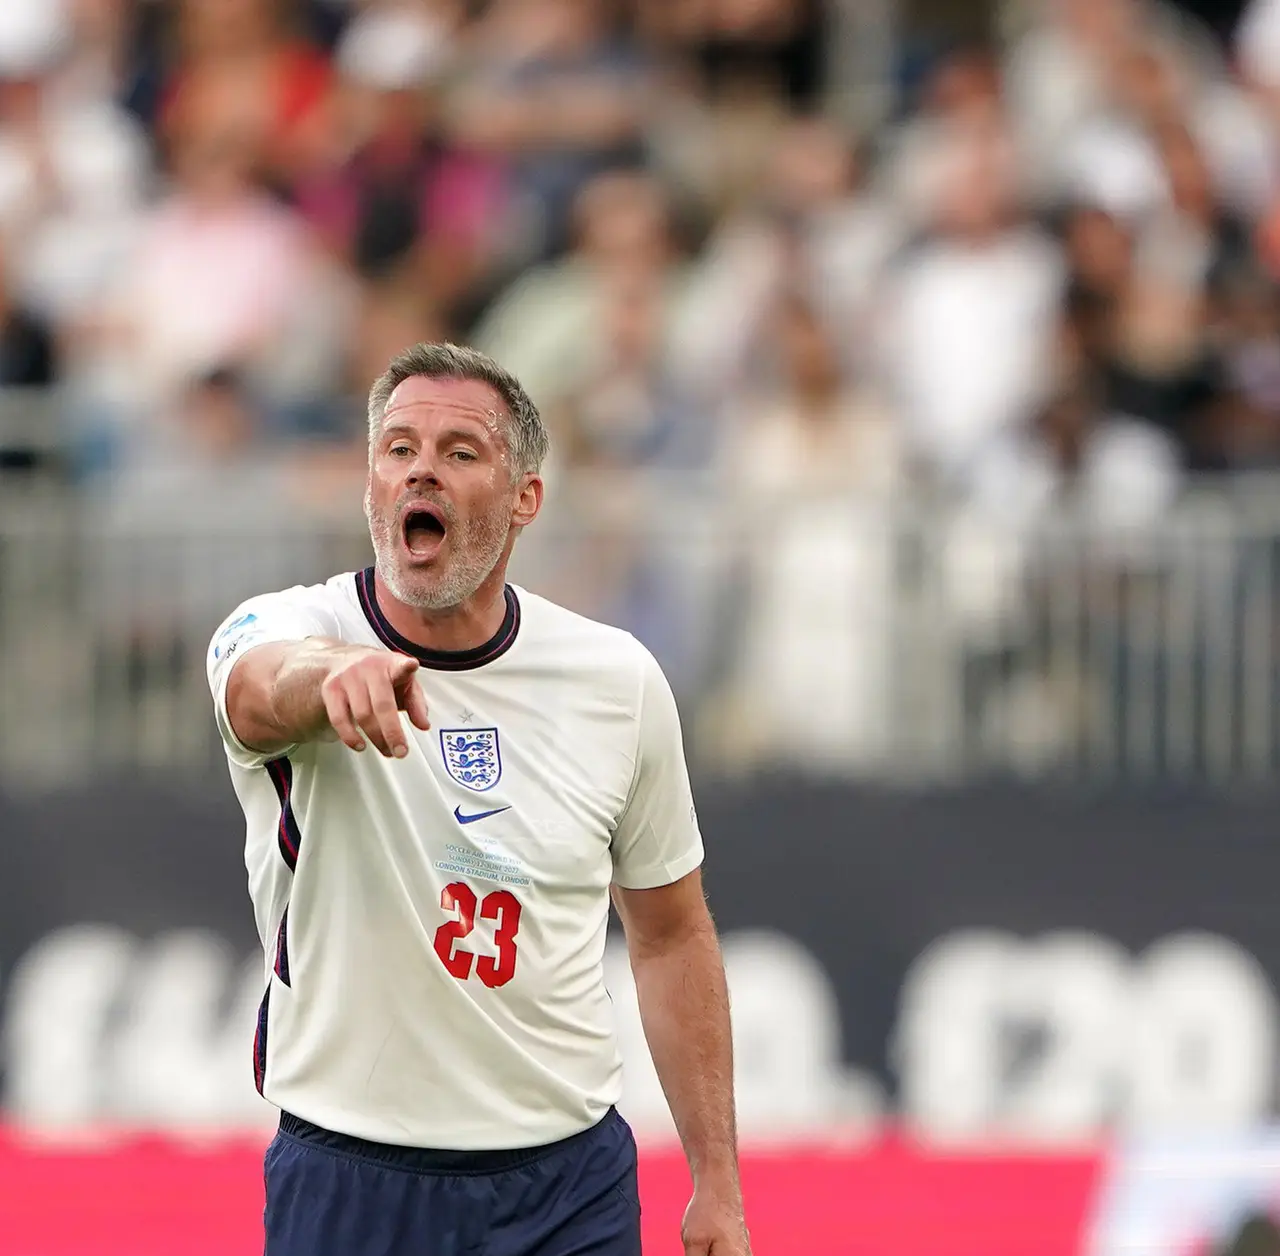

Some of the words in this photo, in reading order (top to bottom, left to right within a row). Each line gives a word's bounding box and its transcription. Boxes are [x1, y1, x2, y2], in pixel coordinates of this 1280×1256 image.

[472, 850, 484, 859] AID
[435, 862, 465, 873] LONDON
[501, 876, 530, 885] LONDON
[433, 882, 522, 988] 23
